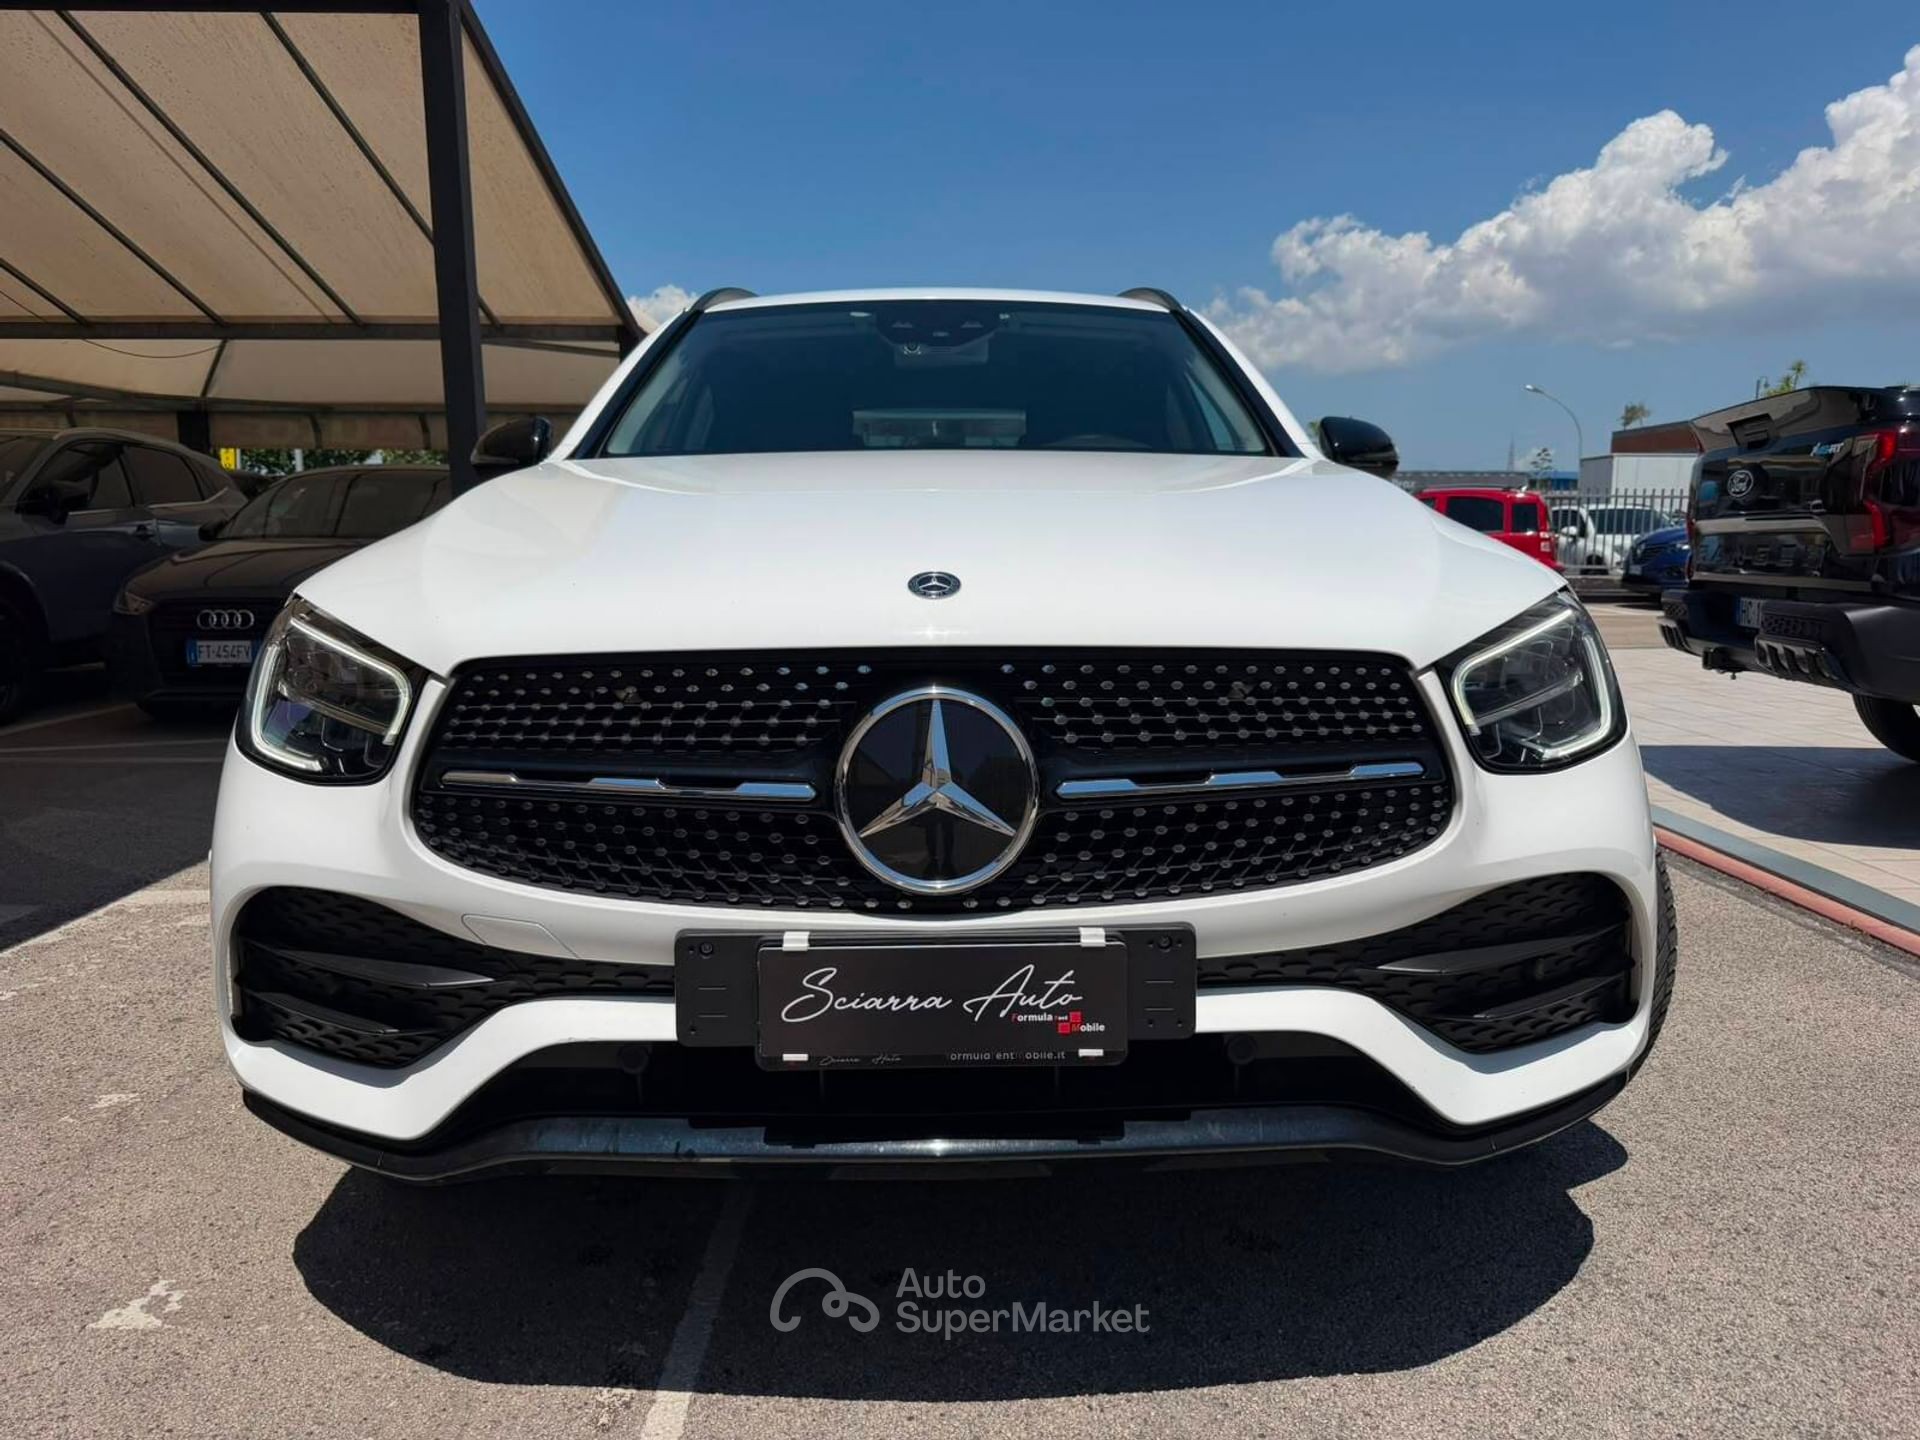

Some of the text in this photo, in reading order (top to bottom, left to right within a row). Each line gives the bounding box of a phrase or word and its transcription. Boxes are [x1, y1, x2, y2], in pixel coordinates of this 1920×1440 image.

[781, 963, 1083, 1022] Sciarra Auto
[1011, 1012, 1053, 1022] Formula
[1071, 1023, 1105, 1032] Mobile
